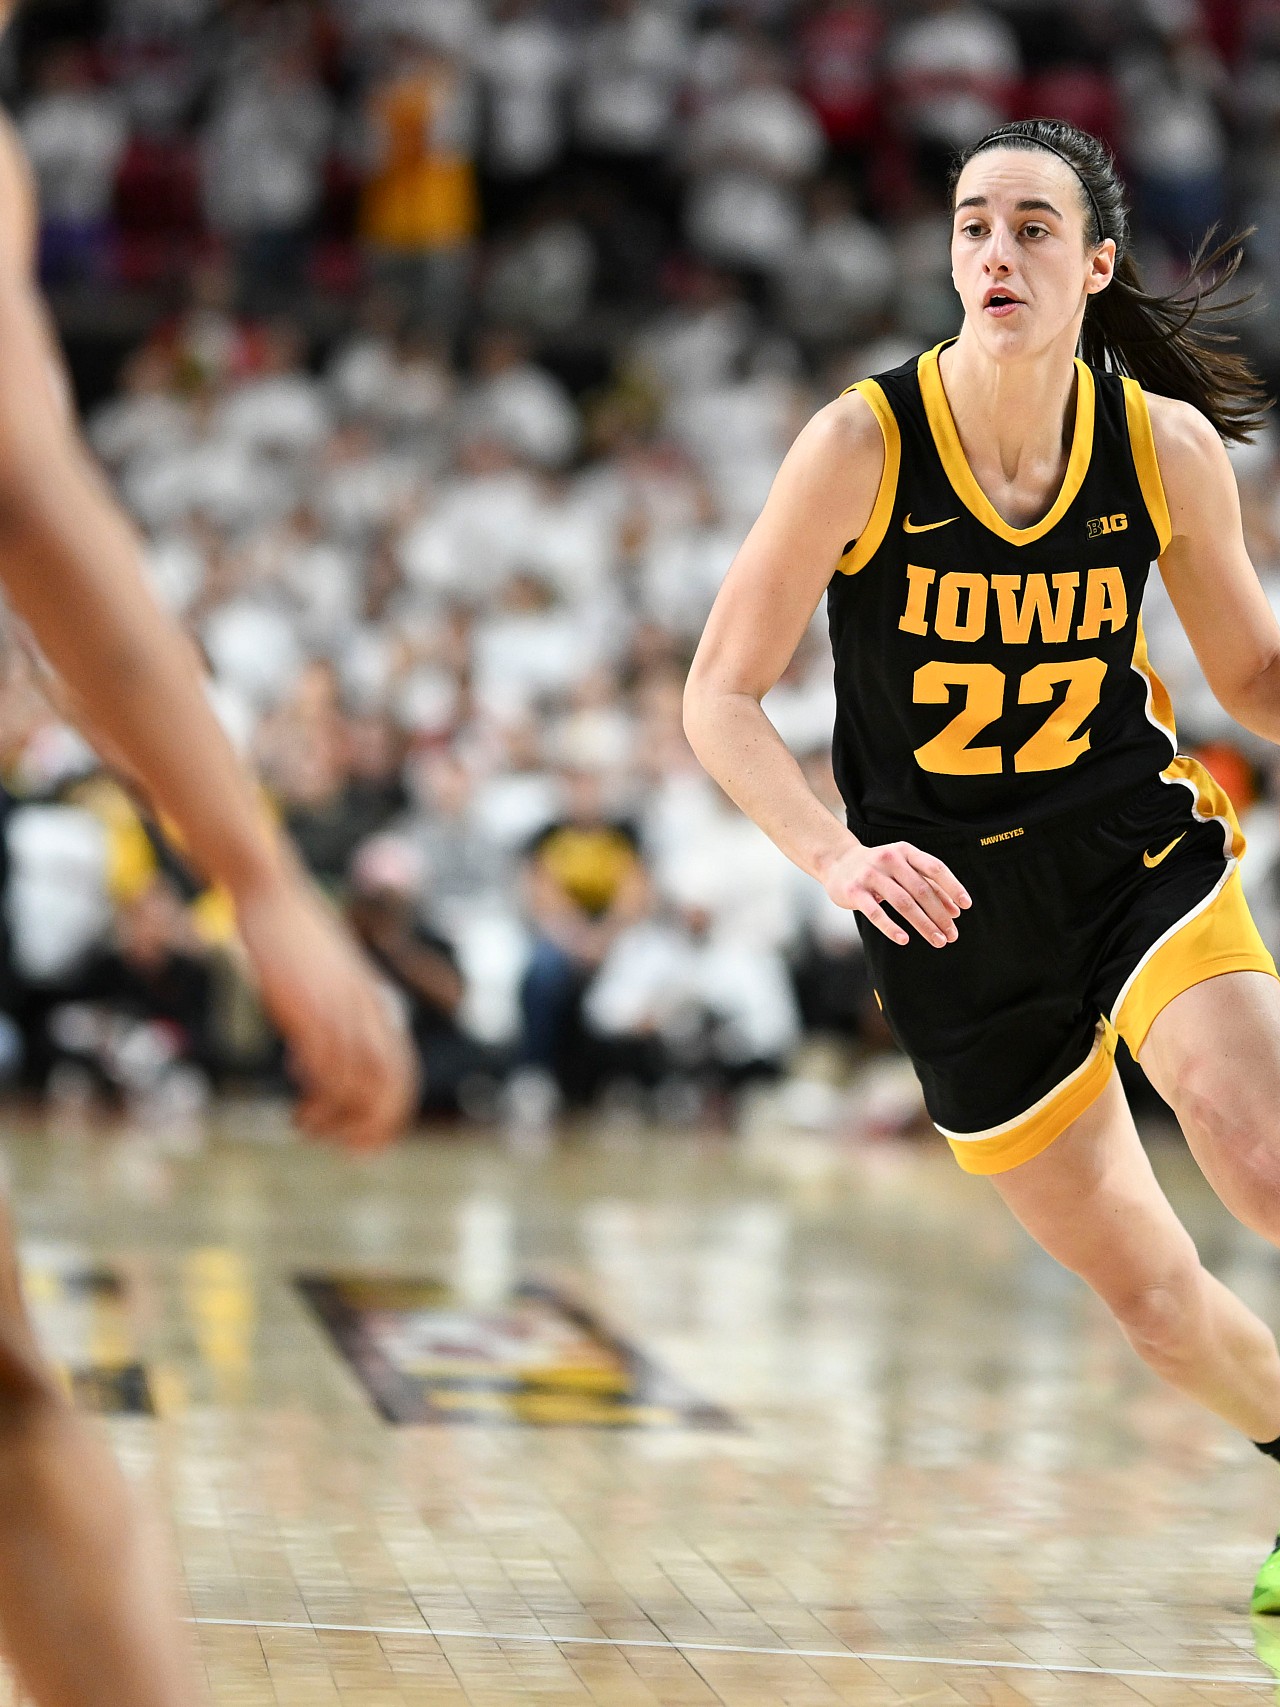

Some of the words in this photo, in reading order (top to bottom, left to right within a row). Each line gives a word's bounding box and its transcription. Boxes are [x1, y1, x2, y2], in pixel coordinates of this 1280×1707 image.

[898, 563, 1129, 645] IOWA
[912, 656, 1108, 776] 22
[980, 827, 1024, 846] HAWKEYES
